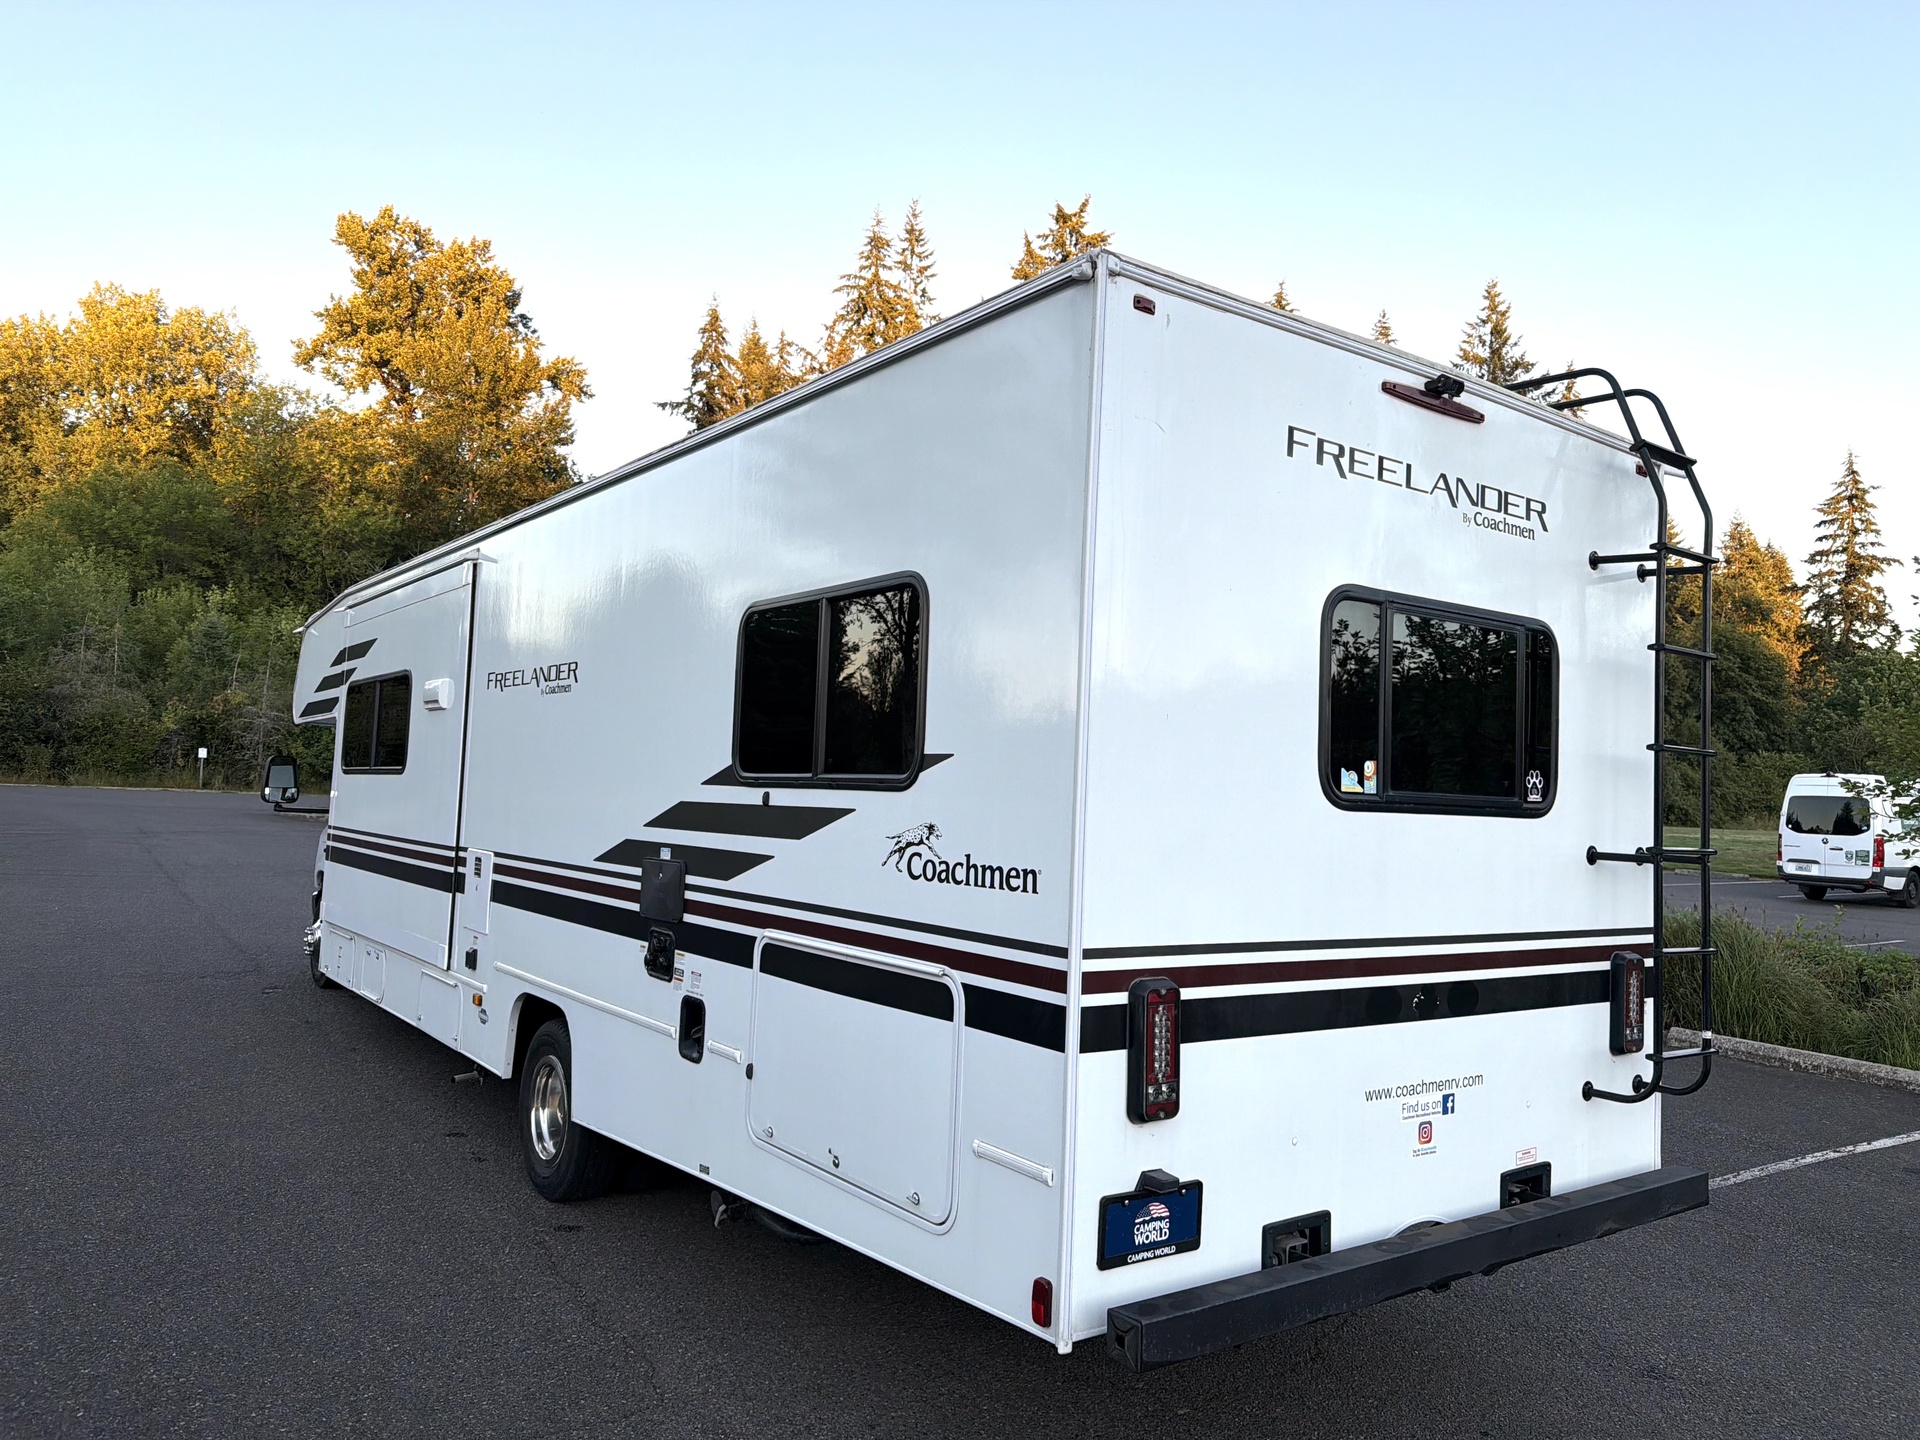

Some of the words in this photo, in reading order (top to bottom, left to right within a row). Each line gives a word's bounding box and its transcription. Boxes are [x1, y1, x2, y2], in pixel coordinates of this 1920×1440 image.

[1286, 424, 1549, 533] FREELANDER
[1462, 512, 1473, 528] By
[1473, 511, 1536, 541] Coachmen
[486, 661, 578, 692] FREELANDER
[545, 683, 572, 695] Coachmen
[906, 851, 1039, 895] Coachmen
[1365, 1074, 1484, 1102] www.coachmenrv.com
[1401, 1100, 1419, 1115] Find
[1420, 1101, 1430, 1111] us
[1431, 1100, 1442, 1110] on
[1134, 1218, 1170, 1235] CAMPING
[1134, 1228, 1169, 1246] WORLD
[1127, 1250, 1155, 1263] CAMPING
[1155, 1245, 1176, 1257] WORLD
